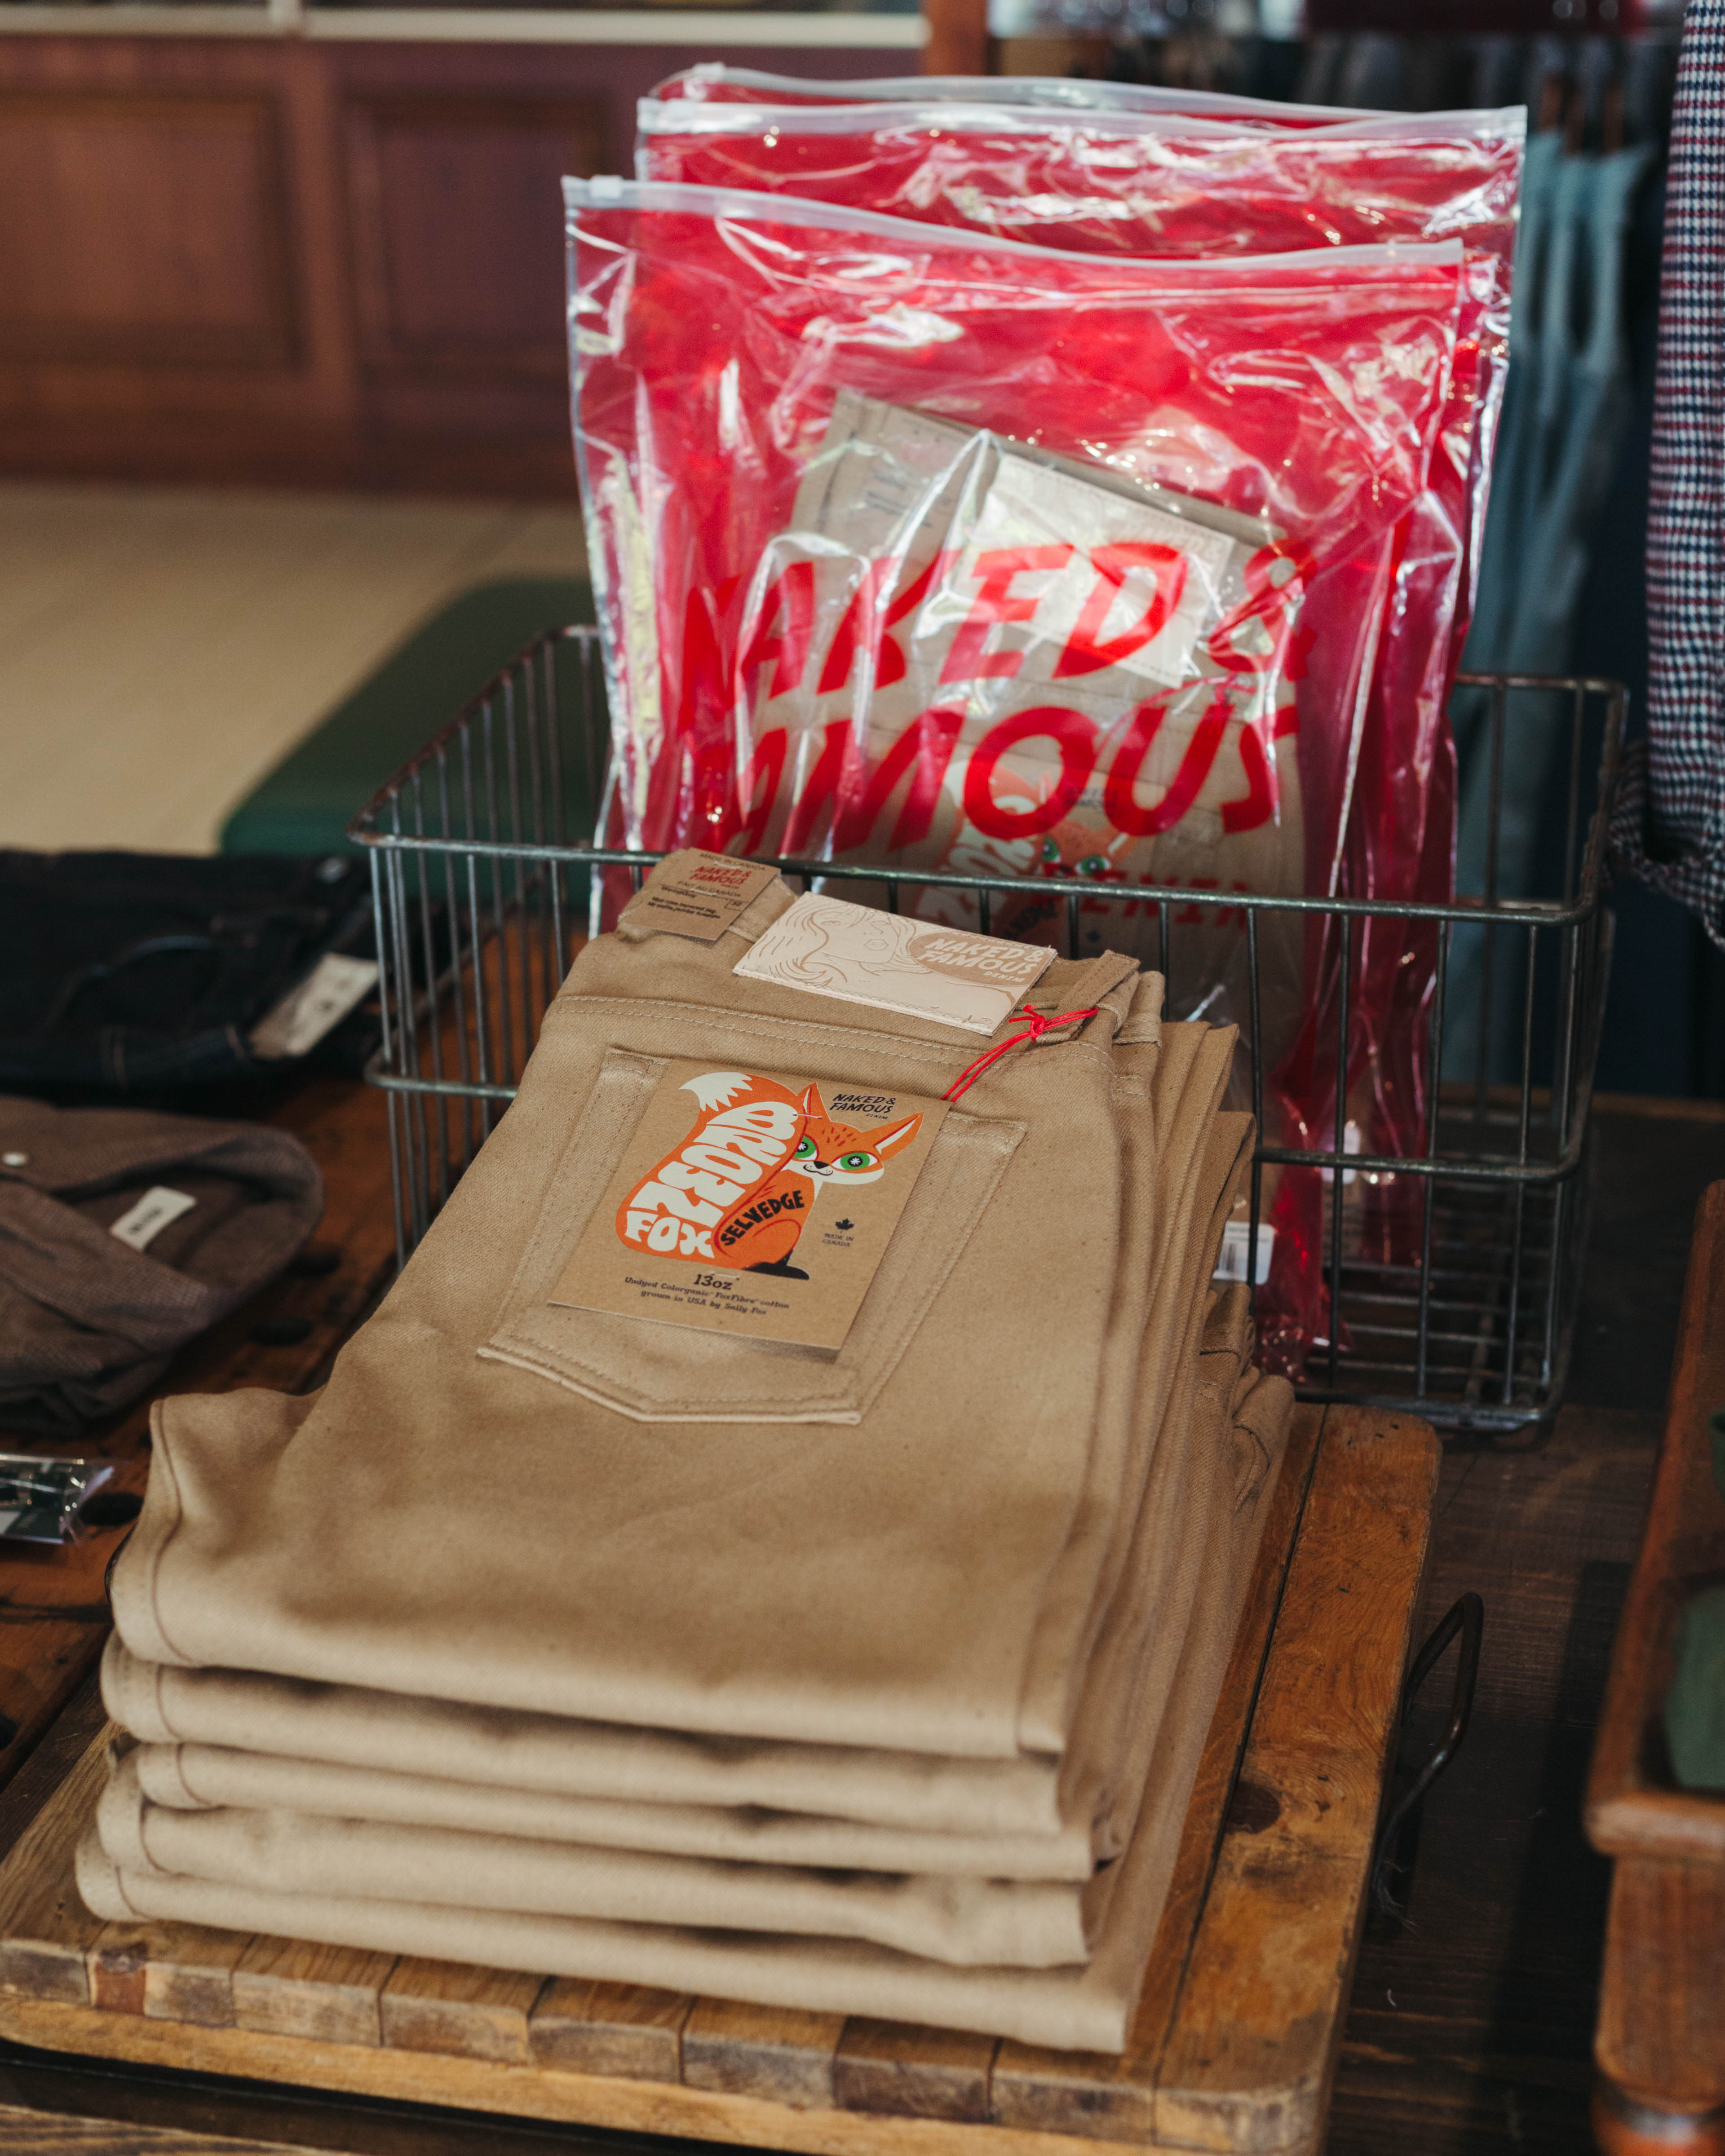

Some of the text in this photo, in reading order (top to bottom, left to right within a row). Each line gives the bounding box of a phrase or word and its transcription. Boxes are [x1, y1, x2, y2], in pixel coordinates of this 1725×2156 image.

[699, 853, 721, 862] MADE
[734, 861, 765, 870] CANADA
[690, 873, 748, 884] FAMOUS
[694, 866, 743, 876] NAKED
[709, 887, 741, 897] CANADA
[924, 938, 1044, 962] NAKED &
[916, 950, 1037, 974] FAMOUS
[983, 971, 1025, 983] DENIM
[832, 1094, 885, 1104] NAKED
[829, 1102, 893, 1113] FAMOUS
[720, 1190, 805, 1246] SELVEDGE
[624, 1211, 715, 1258] FOX
[822, 1239, 850, 1247] CANADA
[693, 1274, 733, 1290] 13oz
[625, 1277, 658, 1287] Undyed
[760, 1301, 790, 1309] cotton
[641, 1290, 671, 1299] grown
[687, 1297, 706, 1306] USA
[710, 1301, 721, 1309] by
[724, 1303, 748, 1313] Sally
